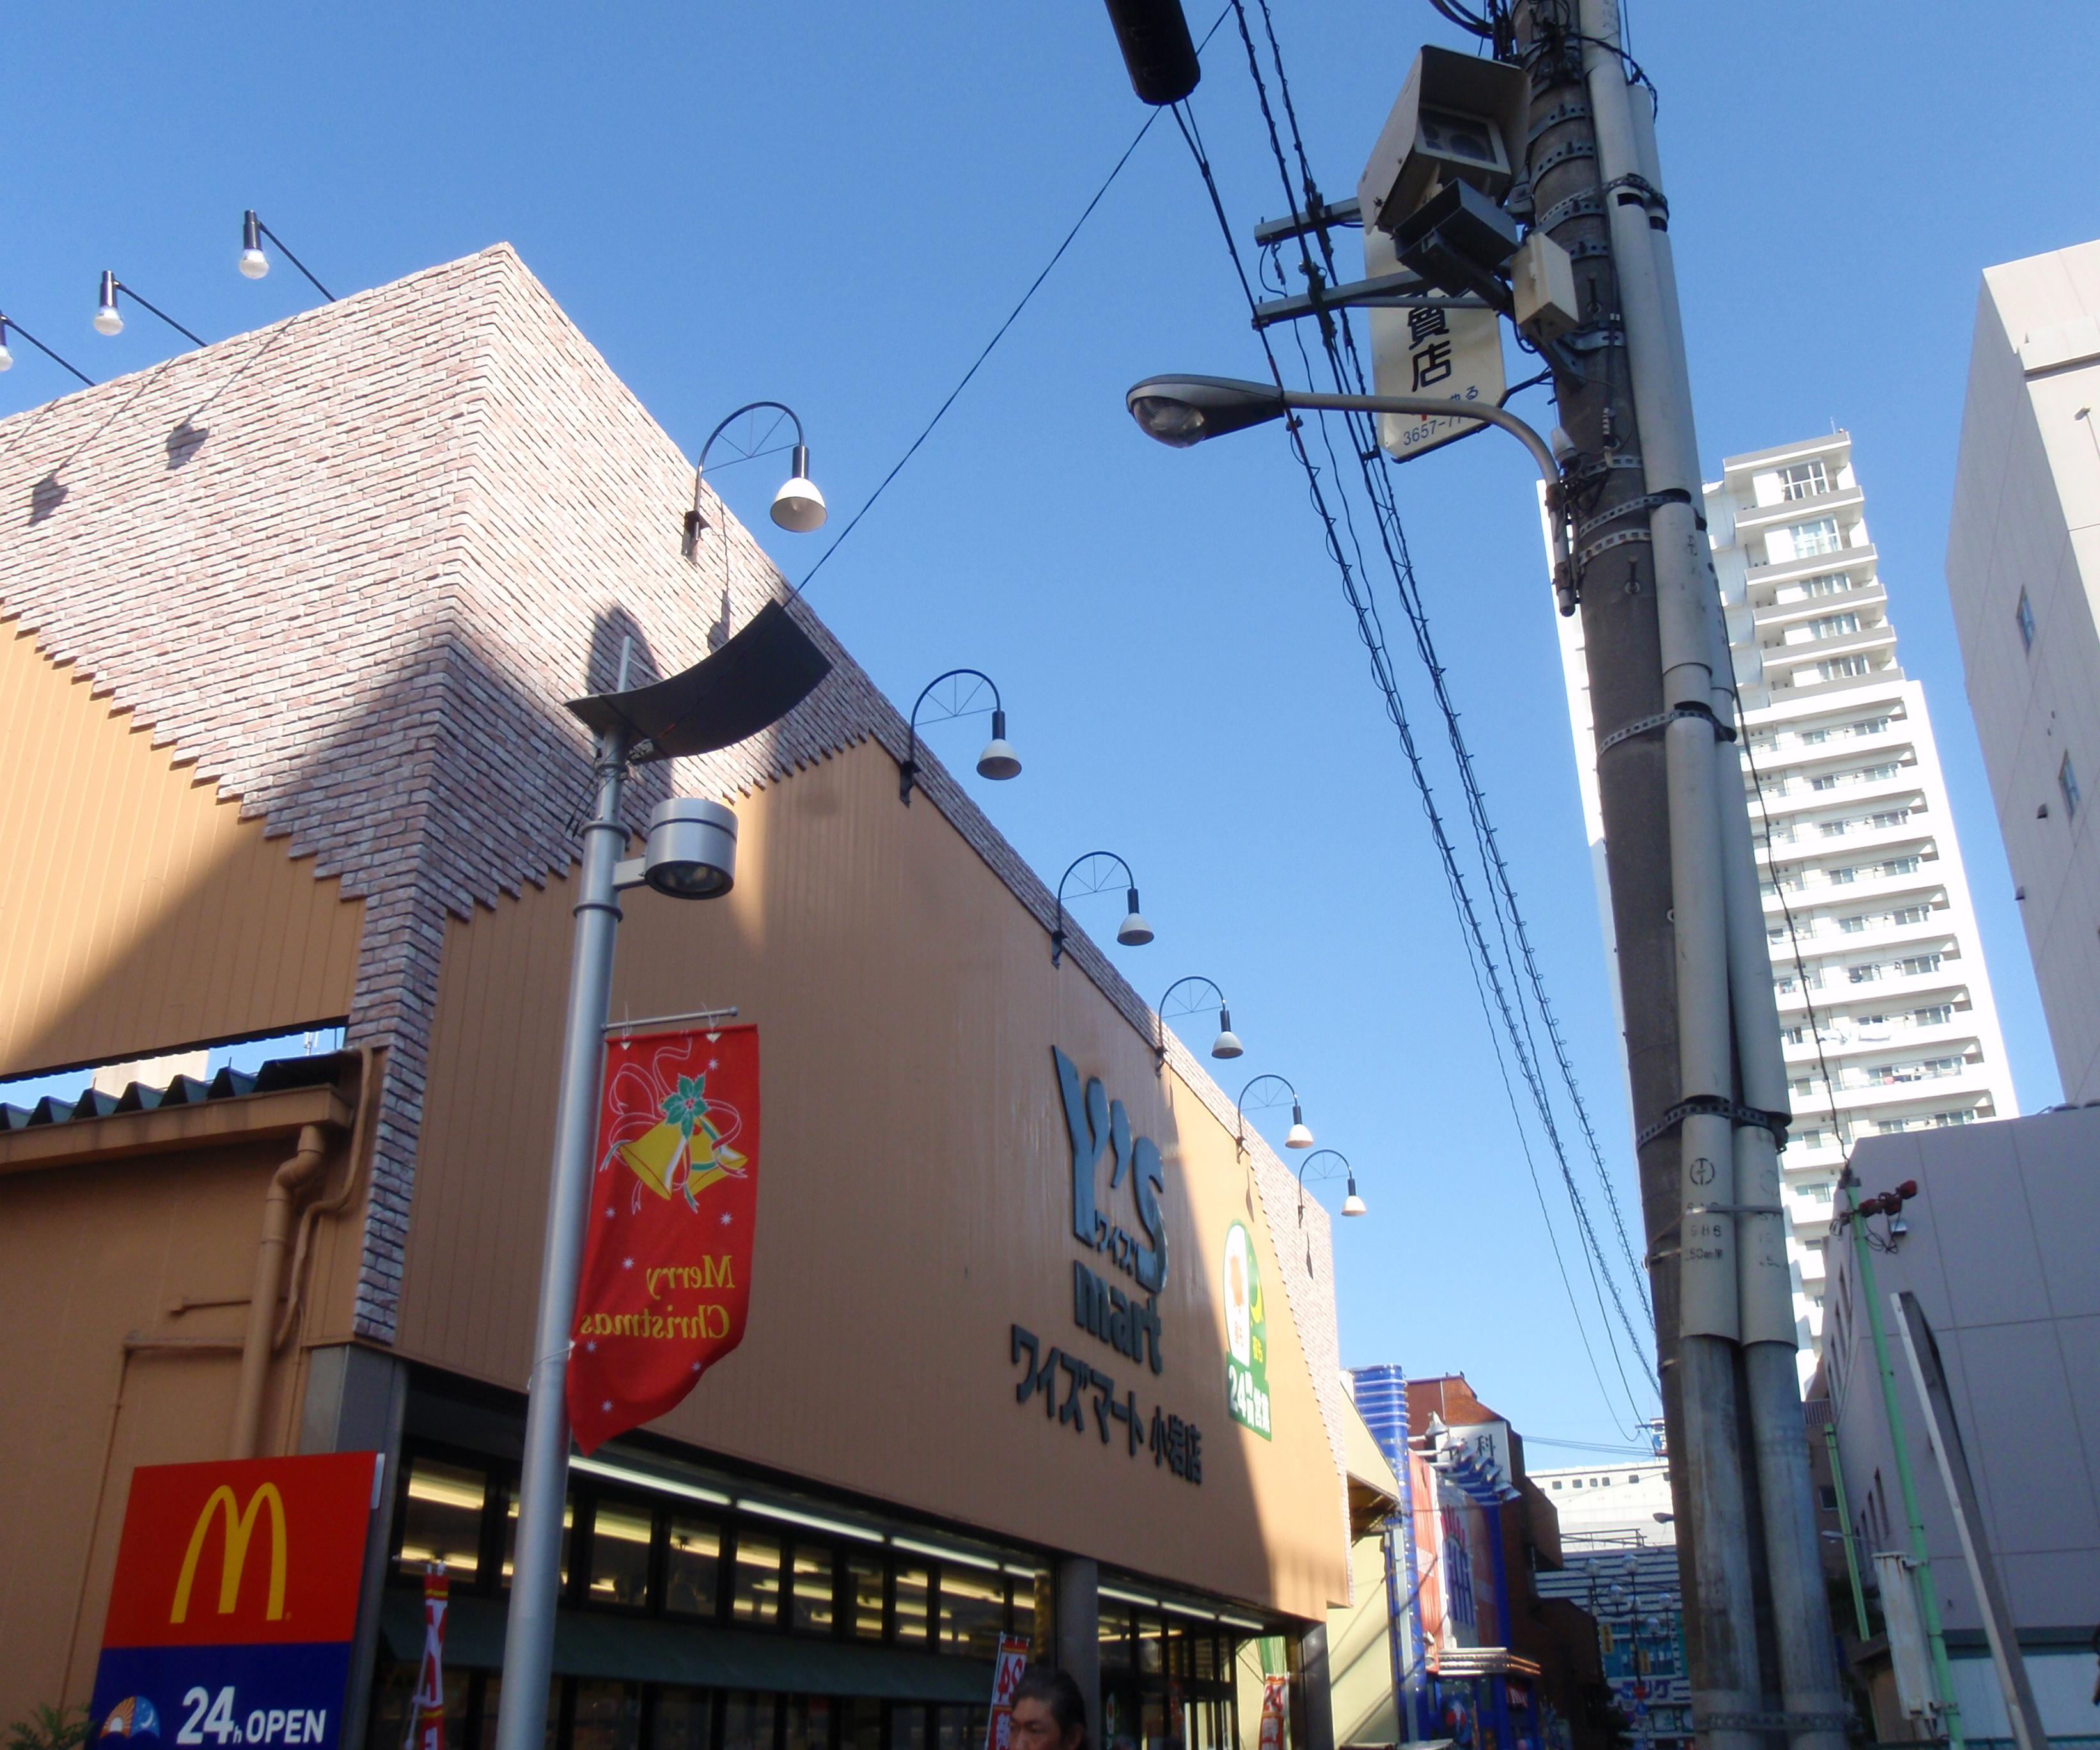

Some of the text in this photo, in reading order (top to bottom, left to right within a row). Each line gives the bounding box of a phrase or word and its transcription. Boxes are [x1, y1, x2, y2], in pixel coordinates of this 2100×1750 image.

[1095, 1210, 1138, 1276] ワイズ
[1074, 1259, 1163, 1375] mart
[1012, 1324, 1202, 1486] ワイズマート 小岩店
[246, 1708, 326, 1744] OPEN
